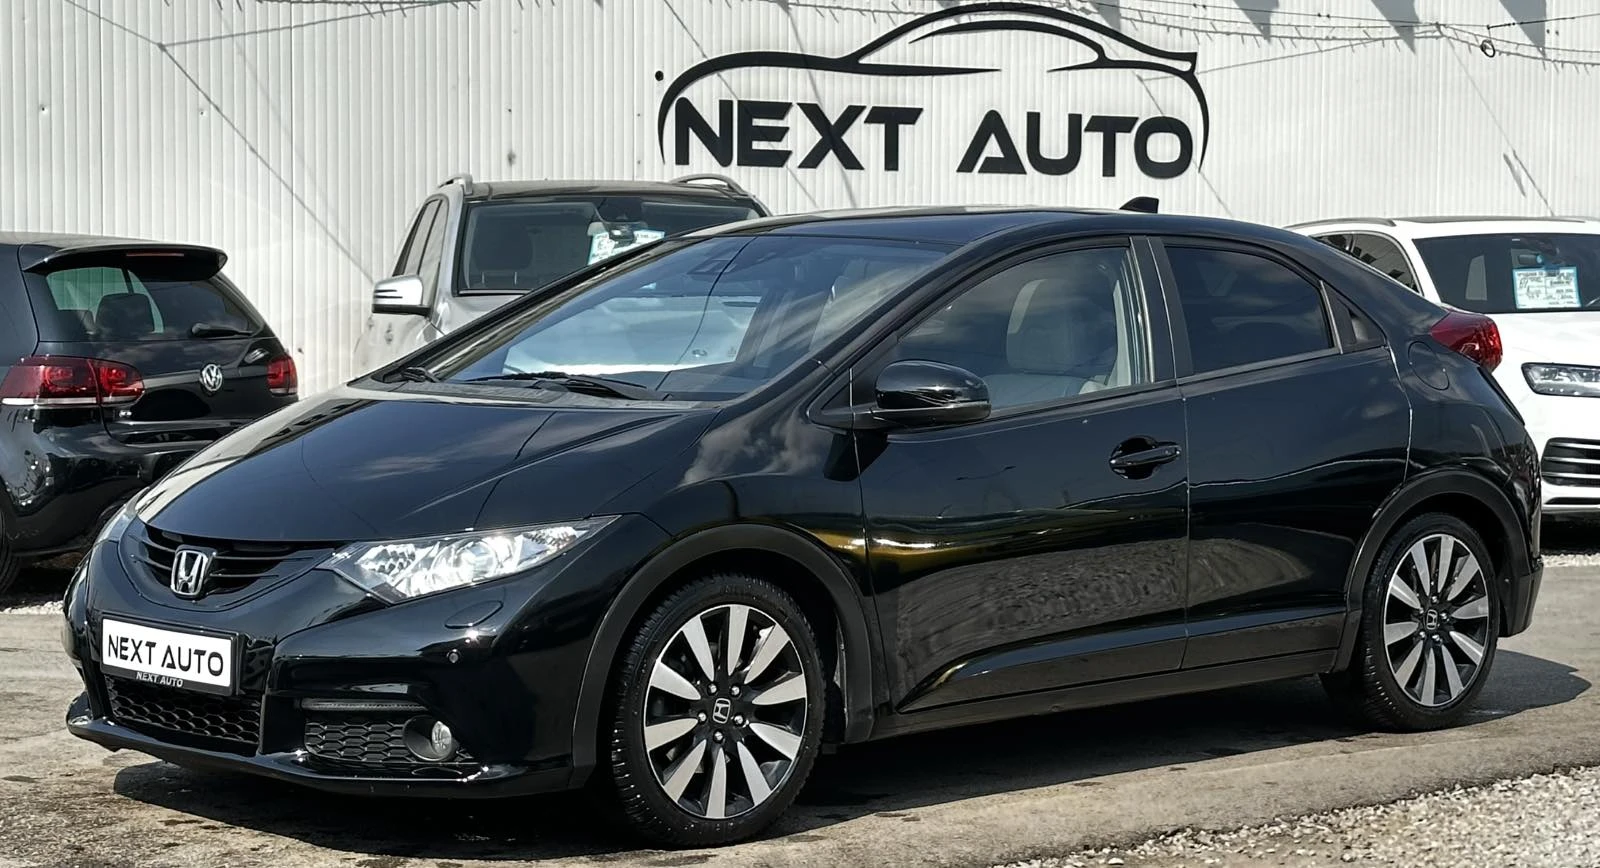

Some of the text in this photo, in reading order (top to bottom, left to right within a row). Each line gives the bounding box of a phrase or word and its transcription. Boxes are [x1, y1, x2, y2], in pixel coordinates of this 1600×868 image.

[675, 97, 1193, 179] NEXT AUTO
[108, 634, 224, 676] NEXT AUTO
[136, 671, 184, 688] NEXT AUTO
